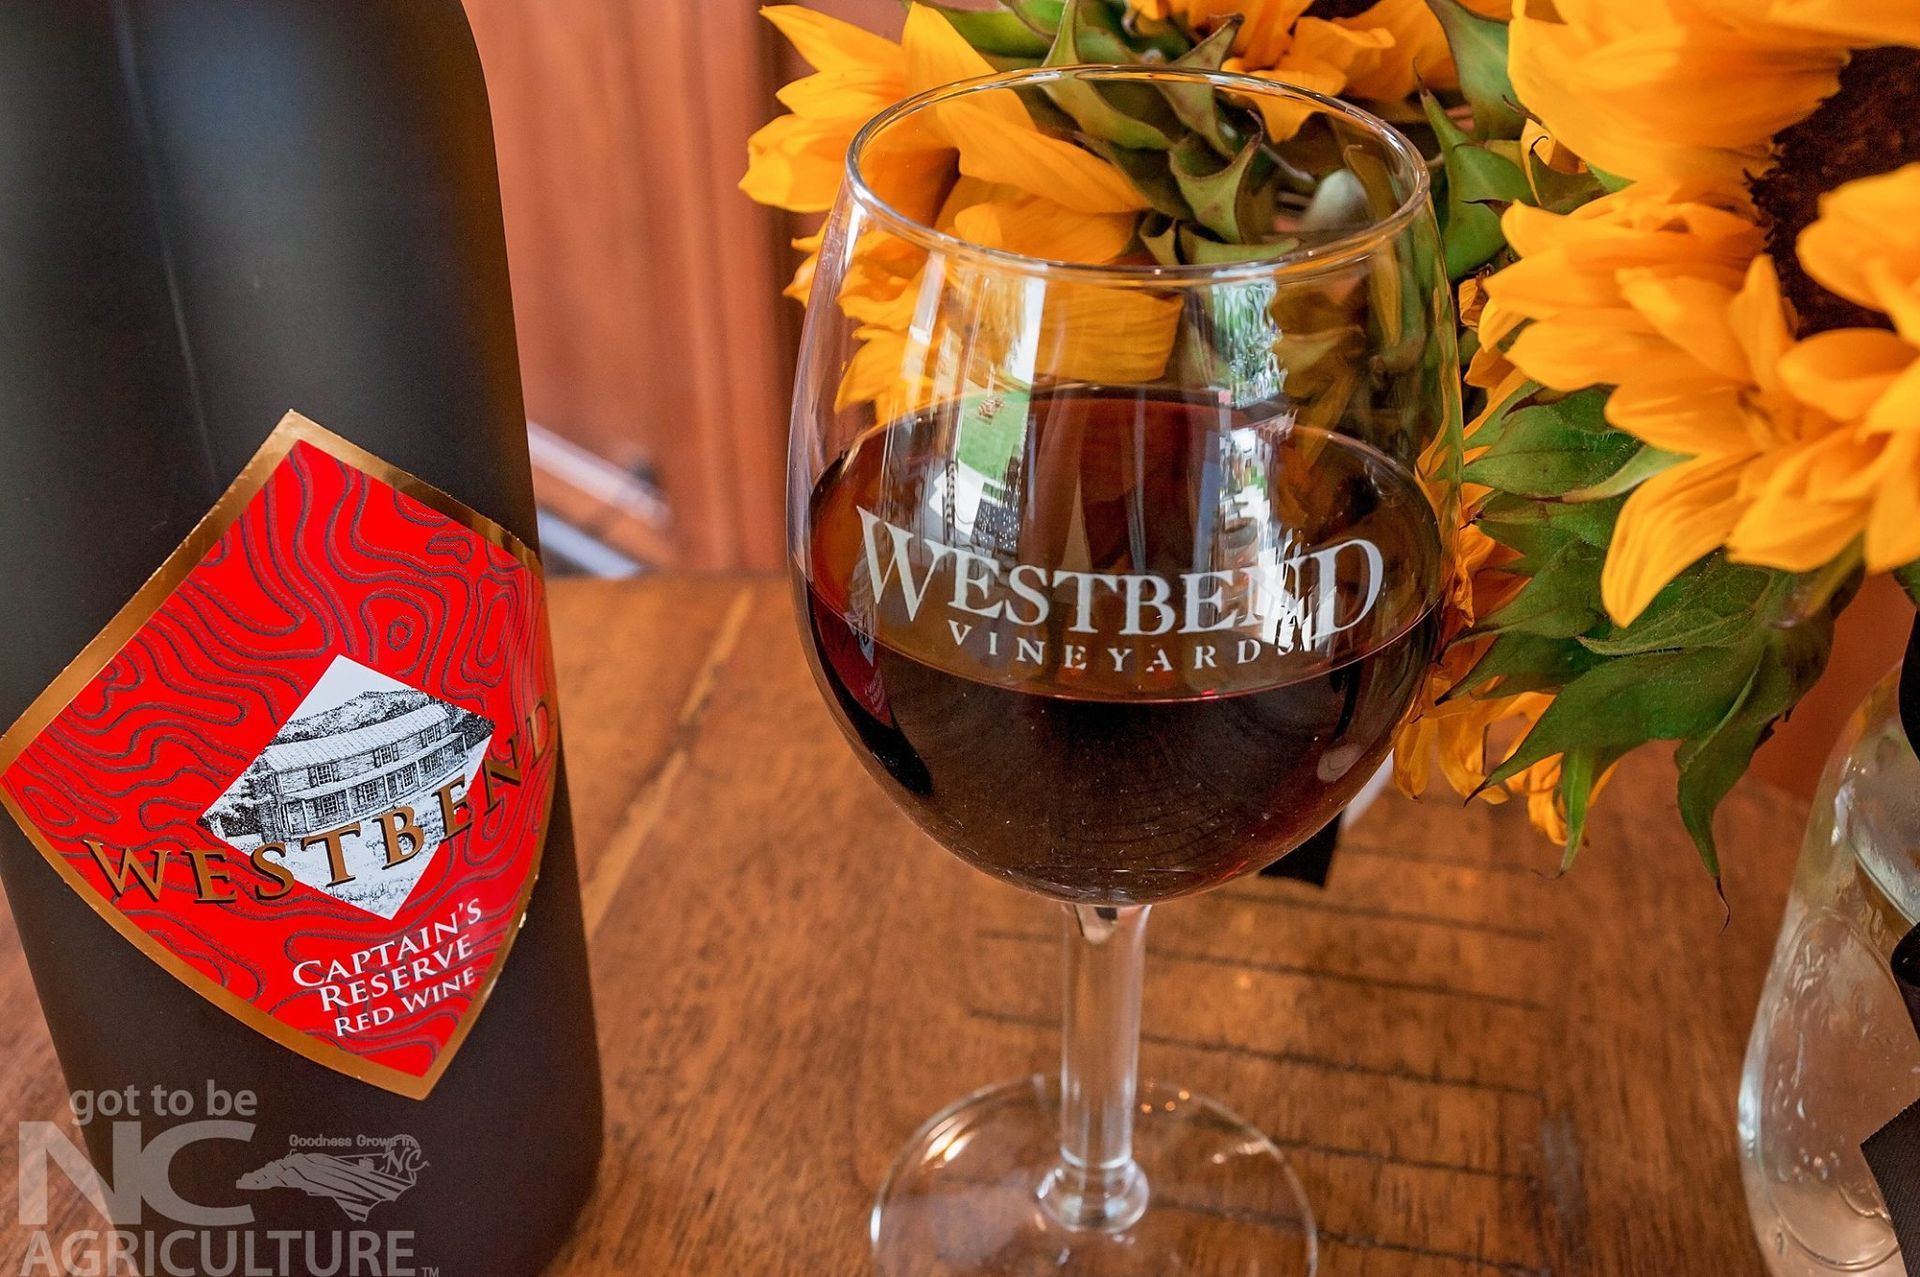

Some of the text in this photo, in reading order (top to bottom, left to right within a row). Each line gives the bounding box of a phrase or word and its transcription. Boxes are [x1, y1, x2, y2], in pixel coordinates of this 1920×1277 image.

[856, 505, 1384, 640] WESTBEND
[82, 699, 555, 903] WESTBEND
[292, 897, 482, 987] CAPTAIN'S
[319, 933, 473, 1012] RESERVE
[333, 966, 476, 1037] RED WINE
